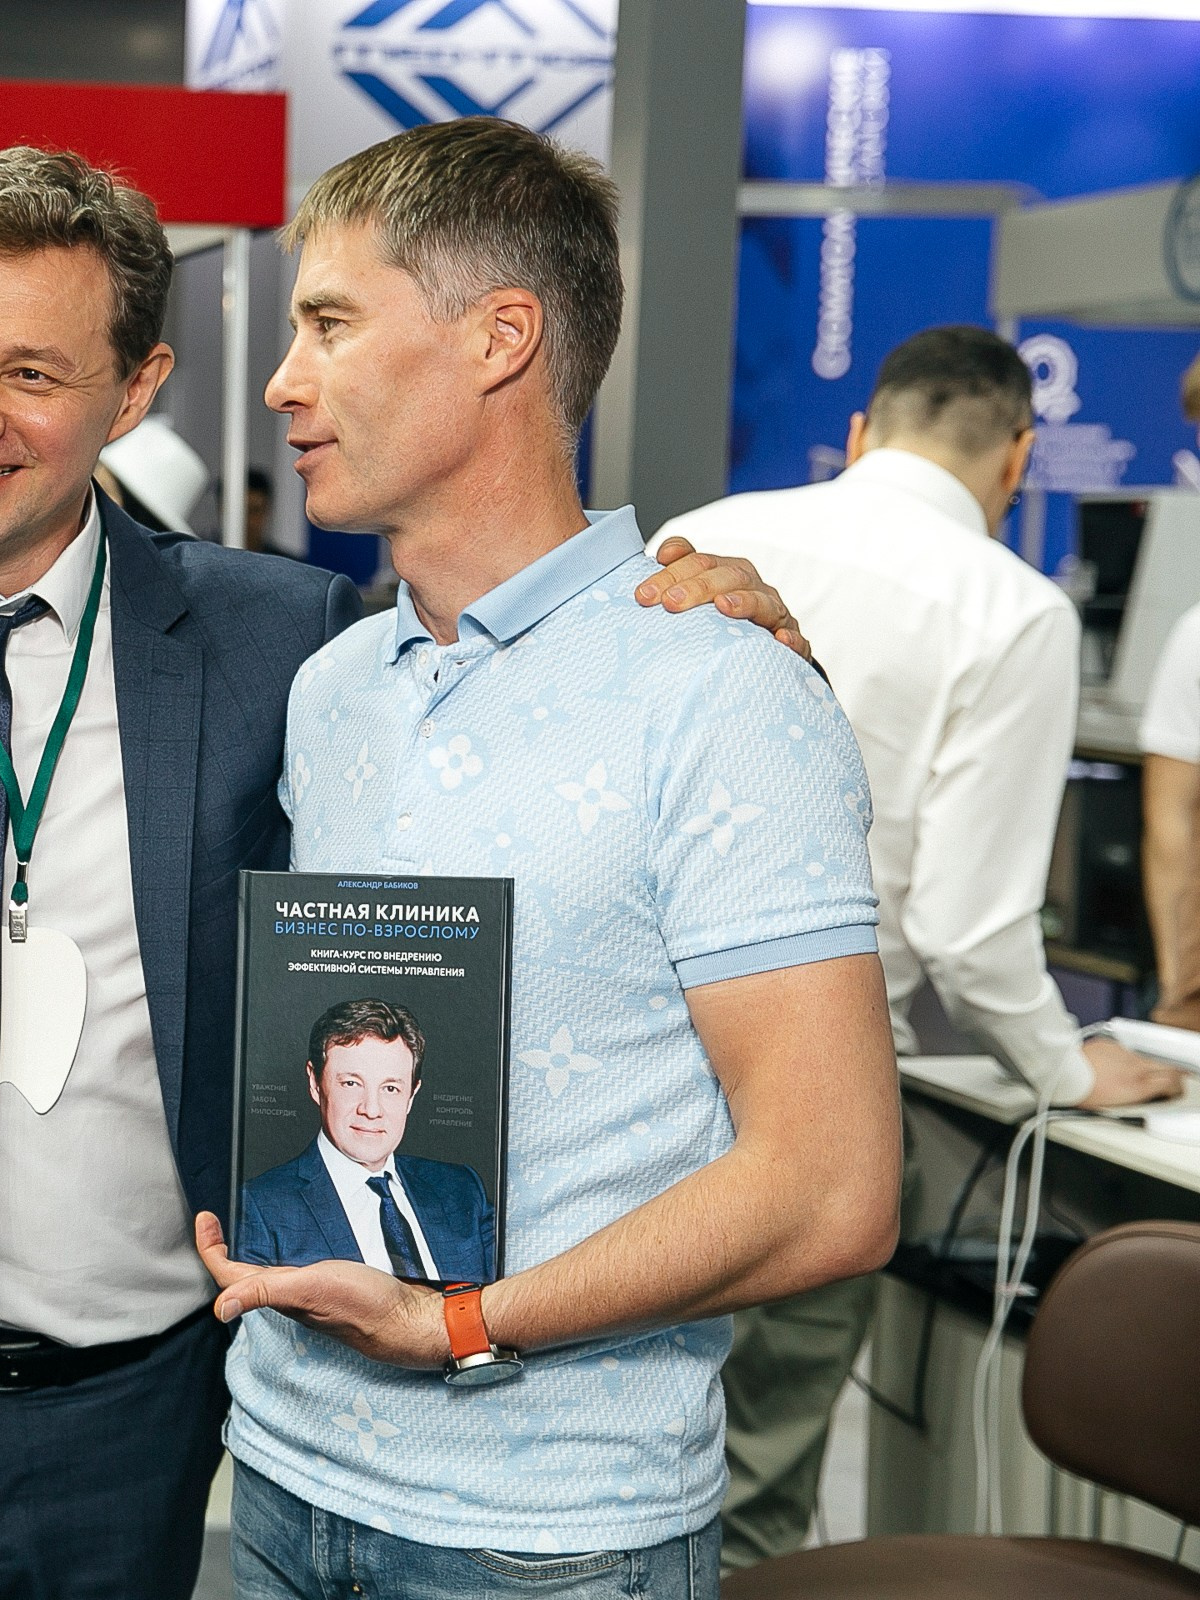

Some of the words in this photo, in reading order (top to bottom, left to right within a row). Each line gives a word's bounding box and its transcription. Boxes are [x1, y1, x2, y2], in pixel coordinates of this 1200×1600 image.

[337, 880, 383, 890] АЛЕКСАНДР
[384, 881, 419, 890] БАБИКОВ
[275, 901, 370, 920] ЧАСТНАЯ
[376, 903, 480, 923] КЛИНИКА
[275, 921, 338, 936] БИЗНЕС
[342, 923, 480, 939] ПО-ВЗРОСЛОМУ
[310, 949, 366, 961] КНИГА-КУРС
[367, 950, 382, 960] ПО
[383, 951, 442, 962] ВНЕДРЕНИЮ
[288, 962, 357, 974] ЭФФЕКТИВНОЙ
[358, 964, 403, 975] СИСТЕМЫ
[404, 966, 465, 978] УПРАВЛЕНИЯ
